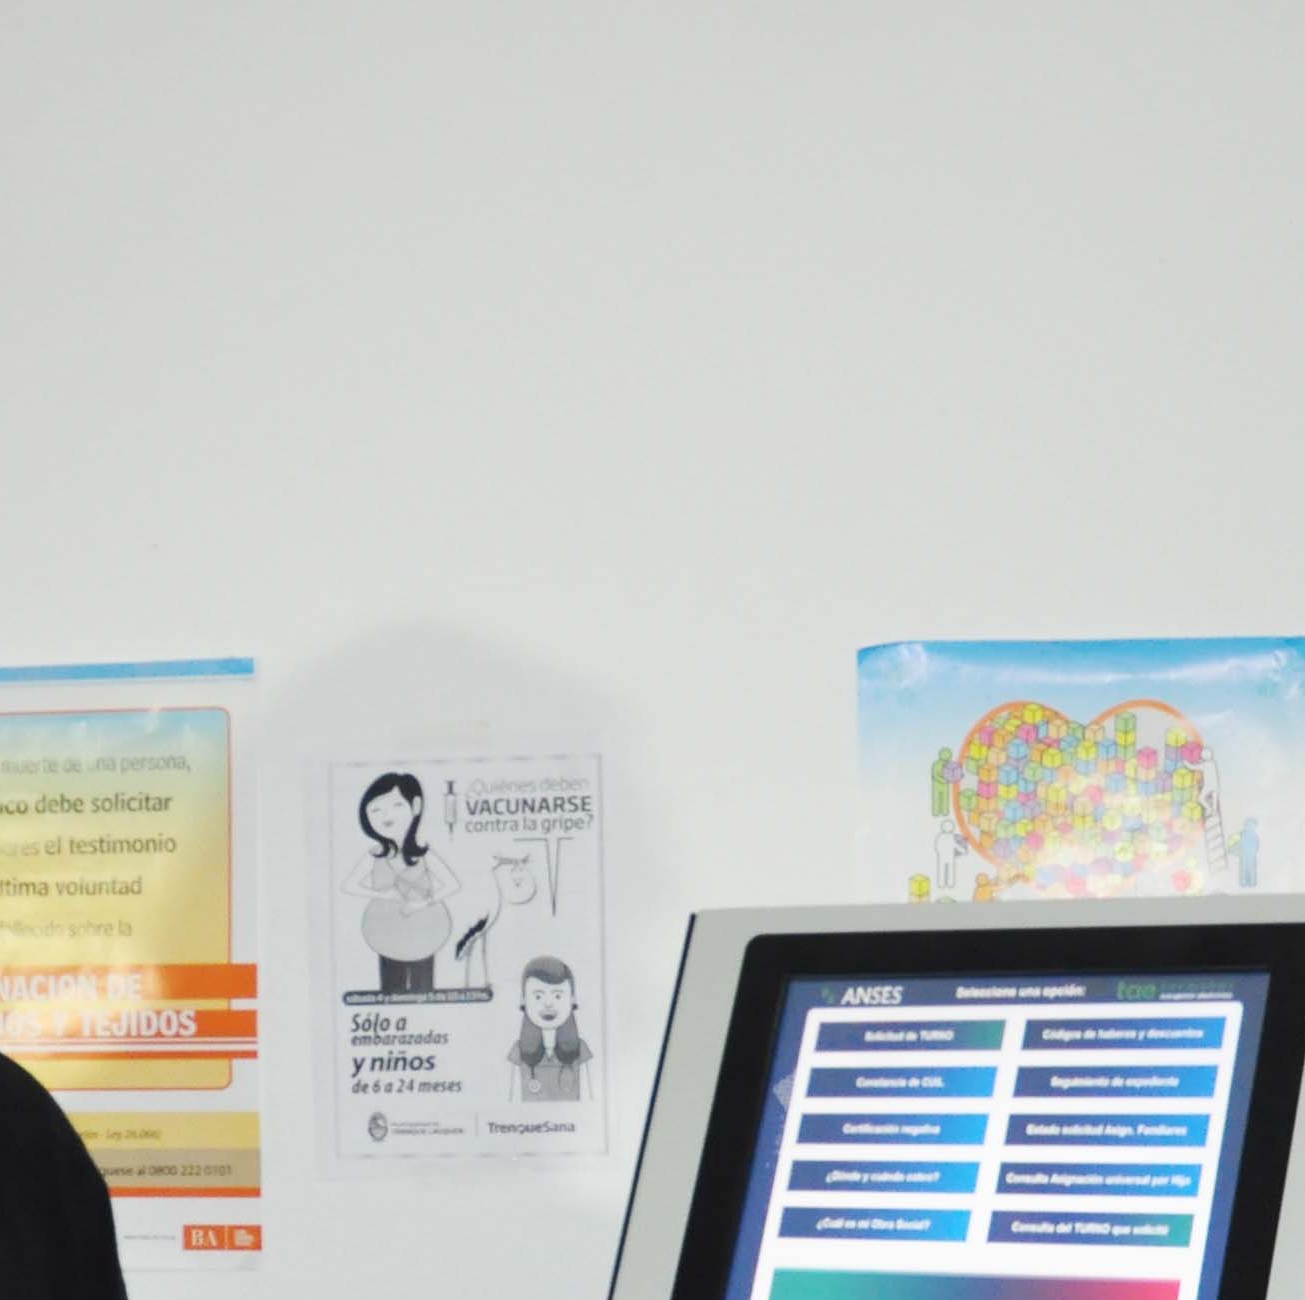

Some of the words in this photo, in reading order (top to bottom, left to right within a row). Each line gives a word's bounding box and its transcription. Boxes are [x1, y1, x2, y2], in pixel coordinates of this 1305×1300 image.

[62, 756, 82, 772] de
[120, 754, 192, 774] persona,
[464, 777, 537, 798] ¿Quiénes
[538, 776, 590, 793] deben
[33, 792, 84, 814] debe
[90, 791, 175, 813] solicitar
[464, 794, 593, 816] VACUNARSE
[463, 815, 519, 834] contra
[522, 815, 538, 832] la
[540, 813, 595, 836] gripe?
[44, 835, 62, 856] el
[68, 833, 177, 855] testimonio
[55, 875, 143, 896] voluntad
[119, 919, 133, 937] la
[107, 973, 143, 1000] DE
[841, 985, 904, 1005] ANSES
[53, 1012, 68, 1037] Y
[80, 1009, 198, 1037] TEJIDOS
[351, 1012, 390, 1035] Sólo
[396, 1016, 407, 1031] a
[350, 1029, 449, 1047] embarazadas
[919, 1029, 955, 1042] TURNO
[1083, 1028, 1097, 1040] de
[1146, 1026, 1205, 1041] descuentos
[351, 1055, 366, 1078] y
[369, 1050, 437, 1073] niños
[351, 1078, 369, 1095] de
[371, 1078, 382, 1094] 6
[383, 1081, 394, 1094] a
[396, 1078, 416, 1094] 24
[417, 1079, 463, 1094] meses
[907, 1076, 920, 1089] de
[1111, 1075, 1125, 1088] de
[486, 1120, 577, 1138] TrenqueSana
[148, 1163, 178, 1177] 0800
[180, 1163, 201, 1177] 222
[191, 1227, 218, 1246] BA
